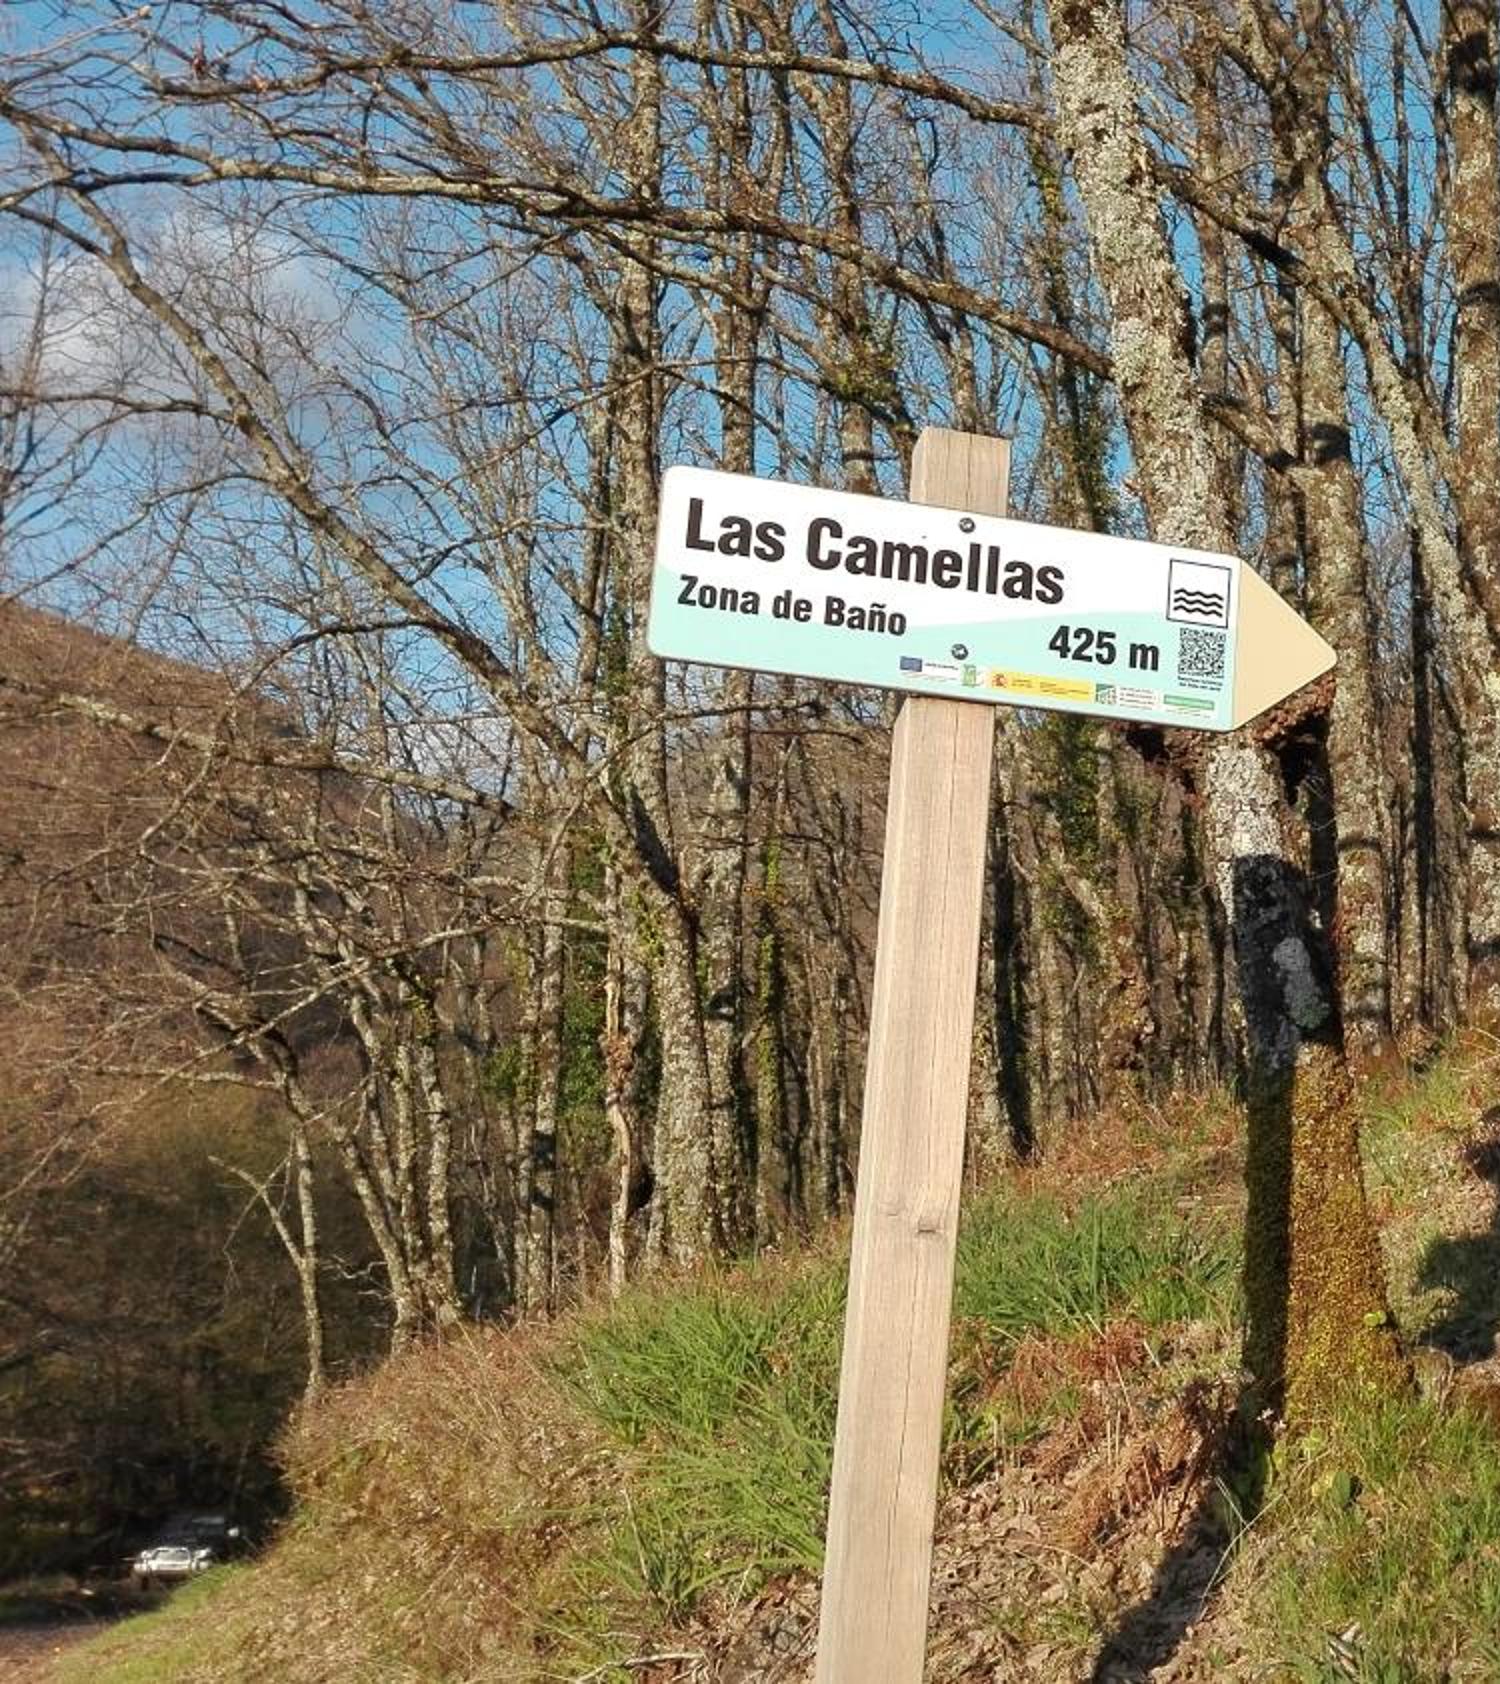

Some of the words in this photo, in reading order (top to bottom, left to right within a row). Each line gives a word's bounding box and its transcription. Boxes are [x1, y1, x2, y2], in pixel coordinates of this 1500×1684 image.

[685, 497, 787, 562] Las
[807, 517, 1065, 606] Camellas
[677, 574, 761, 616] Zona
[772, 590, 813, 624] de
[825, 596, 906, 636] Baño
[1049, 625, 1116, 665] 425
[1129, 643, 1159, 671] m
